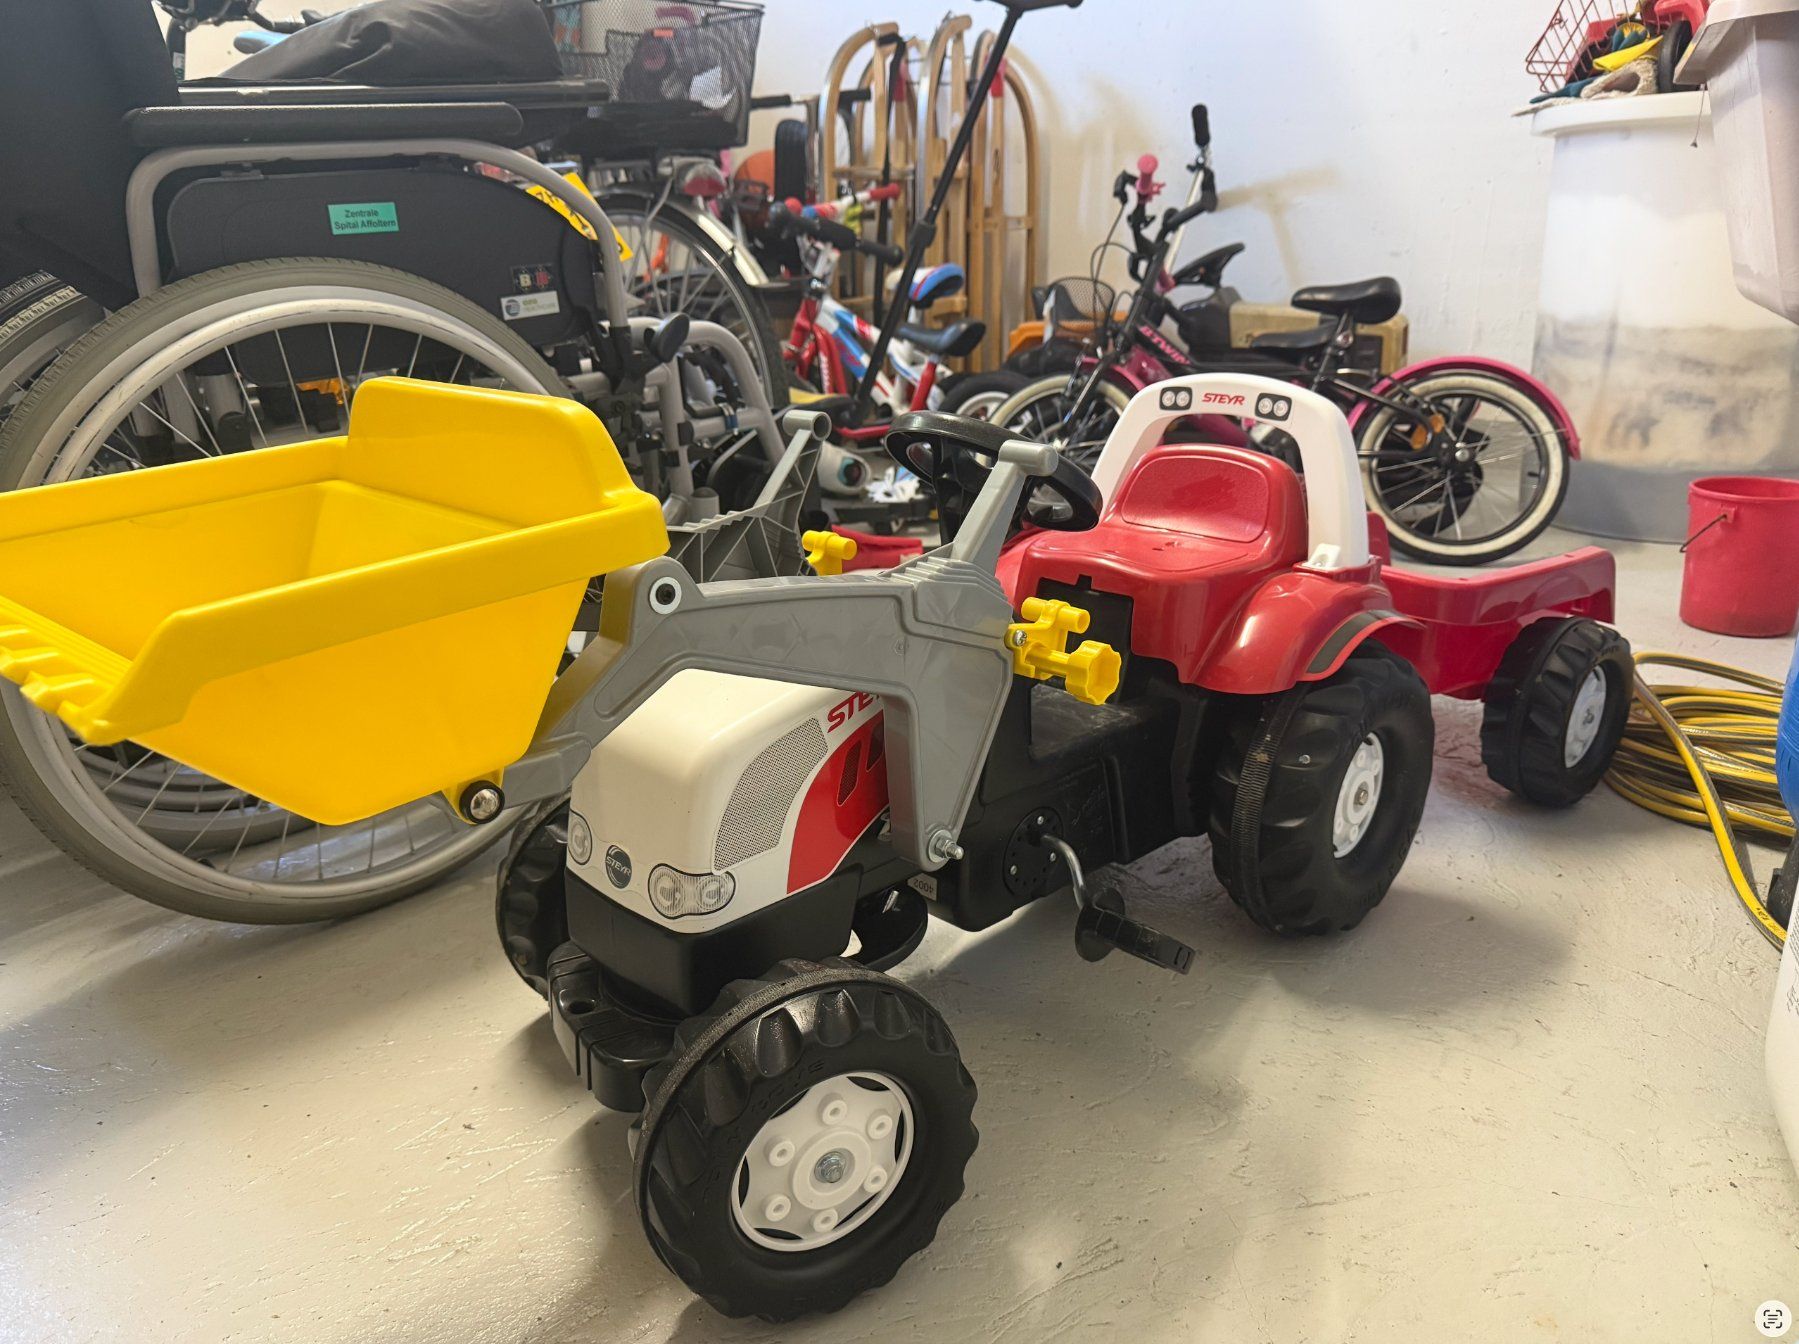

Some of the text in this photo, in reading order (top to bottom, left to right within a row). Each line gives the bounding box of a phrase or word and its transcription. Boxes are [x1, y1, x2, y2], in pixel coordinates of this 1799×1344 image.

[344, 208, 379, 219] Zentrale
[335, 219, 397, 231] Spital Affoltern
[1201, 392, 1245, 406] STEYR
[826, 690, 881, 734] STE
[604, 855, 631, 877] STEYR
